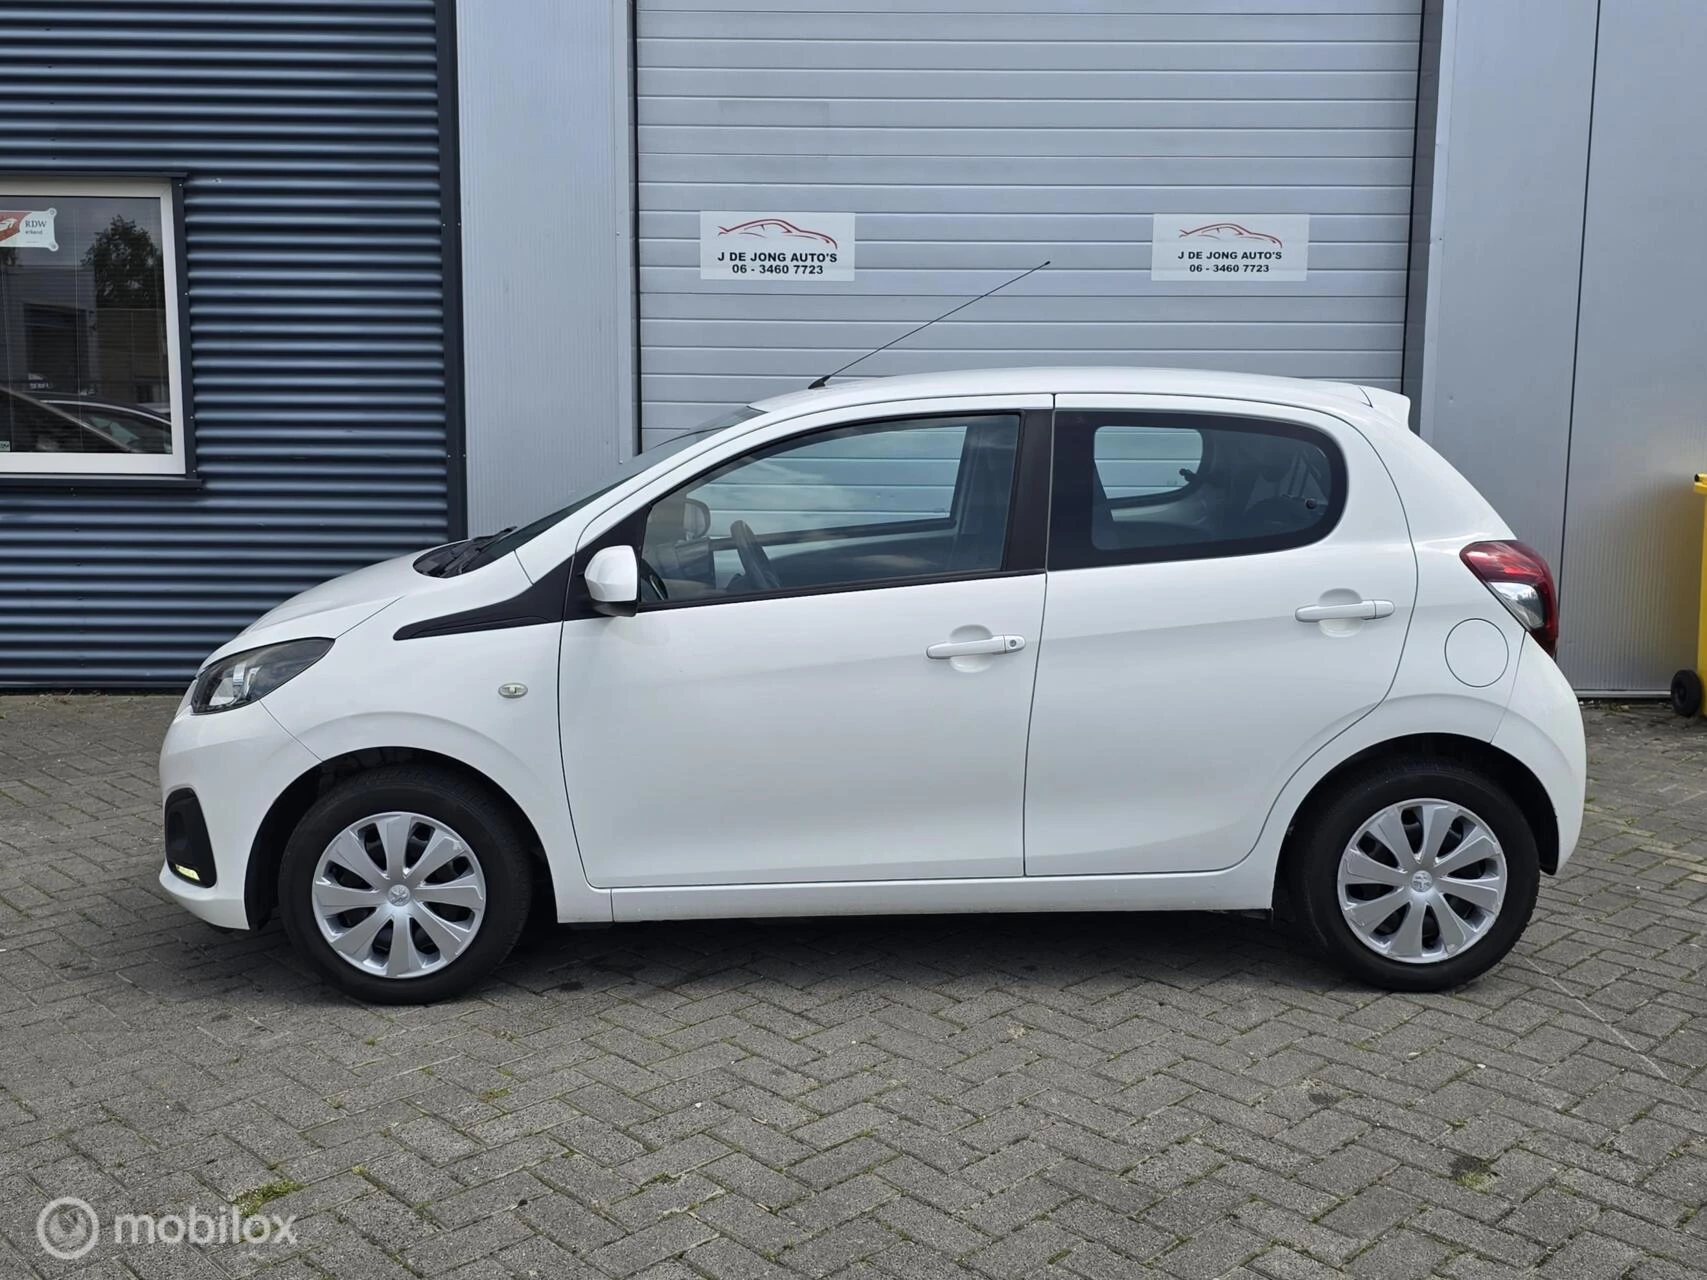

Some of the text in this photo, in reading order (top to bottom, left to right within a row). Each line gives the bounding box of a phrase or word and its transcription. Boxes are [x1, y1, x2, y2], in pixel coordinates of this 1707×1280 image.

[717, 252, 838, 263] J DE JONG AUTO'S
[1178, 252, 1282, 260] J DE JONG AUTO'S
[732, 264, 748, 274] 06
[759, 264, 790, 274] 3460
[793, 265, 824, 274] 7723
[1189, 264, 1203, 273] 06
[1212, 264, 1240, 272] 3460
[1243, 264, 1270, 272] 7723
